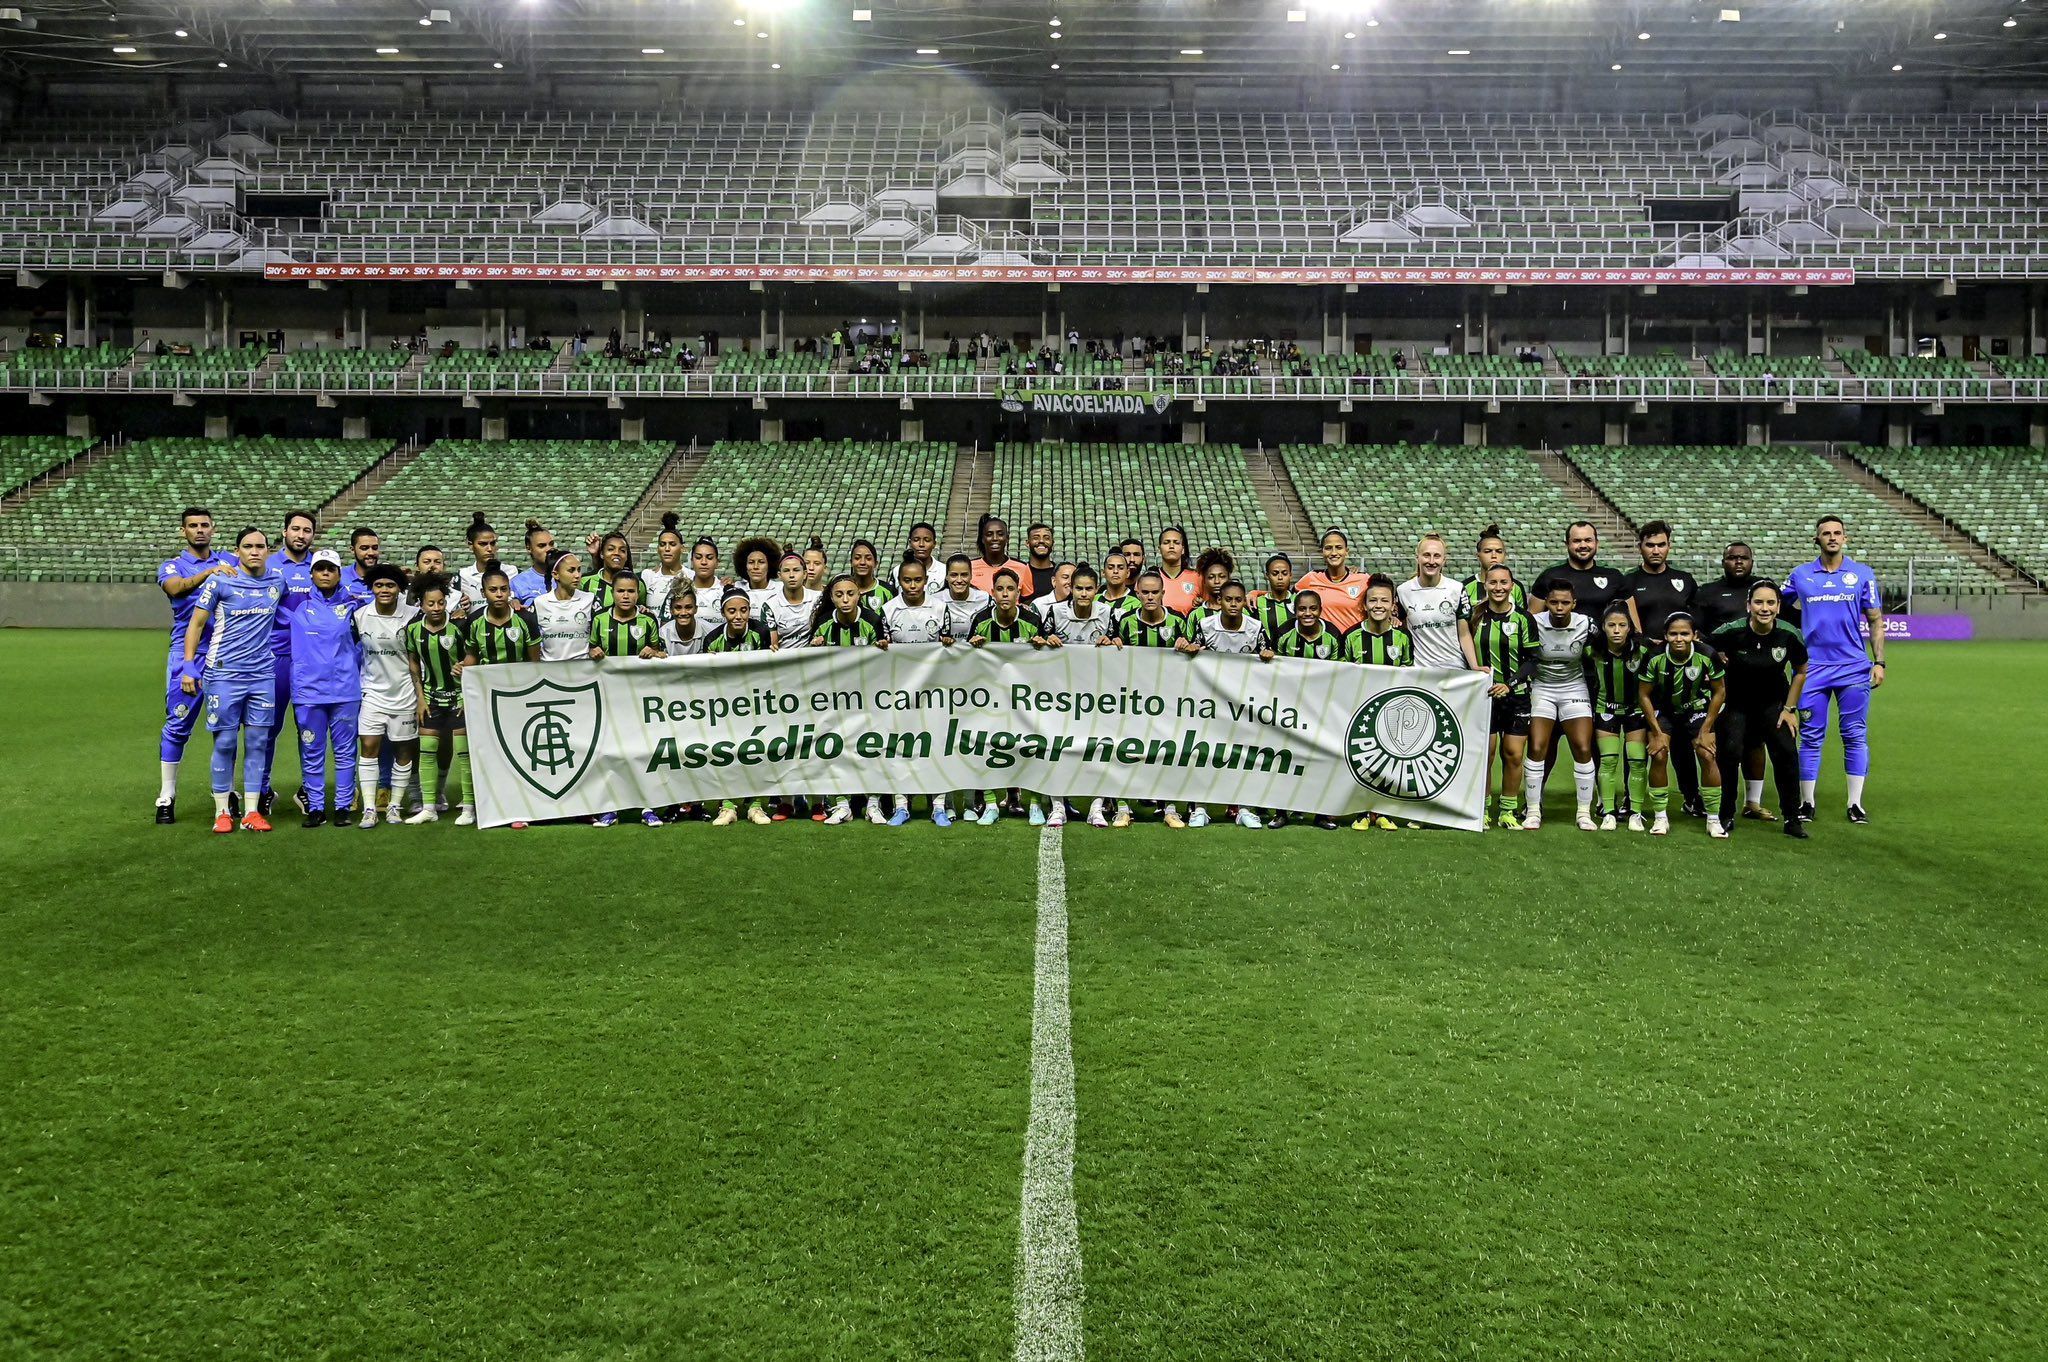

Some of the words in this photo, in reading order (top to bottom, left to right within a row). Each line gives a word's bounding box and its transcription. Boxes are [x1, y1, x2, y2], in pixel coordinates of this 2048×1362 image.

[265, 267, 287, 275] SKY+
[290, 267, 312, 275] SKY+
[315, 267, 337, 276] SKY+
[339, 267, 361, 276] SKY+
[364, 267, 386, 276] SKY+
[388, 267, 410, 276] SKY+
[413, 267, 435, 276] SKY+
[437, 267, 459, 276] SKY+
[461, 267, 483, 276] SKY+
[486, 268, 508, 276] SKY+
[511, 268, 533, 276] SKY+
[536, 268, 558, 276] SKY+
[560, 268, 582, 276] SKY+
[585, 268, 607, 276] SKY+
[610, 268, 632, 277] SKY+
[634, 268, 656, 277] SKY+
[659, 268, 681, 277] SKY+
[684, 268, 706, 277] SKY+
[709, 268, 731, 277] SKY+
[733, 268, 755, 277] SKY+
[758, 268, 780, 277] SKY+
[783, 269, 805, 277] SKY+
[807, 269, 829, 277] SKY+
[832, 269, 854, 277] SKY+
[857, 269, 879, 277] SKY+
[882, 269, 904, 277] SKY+
[907, 269, 929, 278] SKY+
[932, 269, 954, 278] SKY+
[956, 269, 978, 278] SKY+
[981, 269, 1003, 278] SKY+
[1006, 269, 1028, 278] SKY+
[1031, 269, 1053, 278] SKY+
[1056, 269, 1078, 278] SKY+
[1081, 269, 1103, 278] SKY+
[1106, 270, 1128, 278] SKY+
[1131, 270, 1153, 278] SKY+
[1155, 270, 1177, 278] SKY+
[1180, 270, 1202, 278] SKY+
[1205, 270, 1227, 279] SKY+
[1230, 270, 1252, 279] SKY+
[1255, 270, 1277, 279] SKY+
[1280, 270, 1302, 279] SKY+
[1305, 270, 1327, 279] SKY+
[1330, 270, 1352, 279] SKY+
[1354, 270, 1376, 279] SKY+
[1380, 270, 1402, 279] SKY+
[1405, 271, 1427, 279] SKY+
[1430, 271, 1452, 279] SKY+
[1455, 271, 1477, 279] SKY+
[1480, 271, 1502, 279] SKY+
[1505, 271, 1527, 279] SKY+
[1530, 271, 1552, 280] SKY+
[1555, 271, 1577, 280] SKY+
[1580, 271, 1602, 280] SKY+
[1605, 271, 1627, 280] SKY+
[1630, 271, 1652, 280] SKY+
[1655, 271, 1677, 280] SKY+
[1680, 271, 1702, 280] SKY+
[1705, 272, 1727, 280] SKY+
[1730, 272, 1752, 280] SKY+
[1755, 272, 1777, 280] SKY+
[1780, 272, 1802, 280] SKY+
[1805, 272, 1827, 280] SKY+
[1829, 272, 1851, 281] SKY+
[1033, 394, 1145, 414] AVACOELHADA
[208, 695, 219, 708] 25
[643, 688, 799, 726] Respeito
[811, 691, 862, 711] em
[875, 688, 998, 714] campo.
[1012, 684, 1164, 720] Respeito
[1177, 698, 1215, 719] na
[1228, 697, 1307, 729] vida.
[646, 723, 843, 773] Assédio
[857, 732, 931, 758] em
[944, 719, 1073, 768] lugar
[1083, 730, 1305, 776] nenhum.
[1350, 737, 1458, 797] PALMEIRAS
